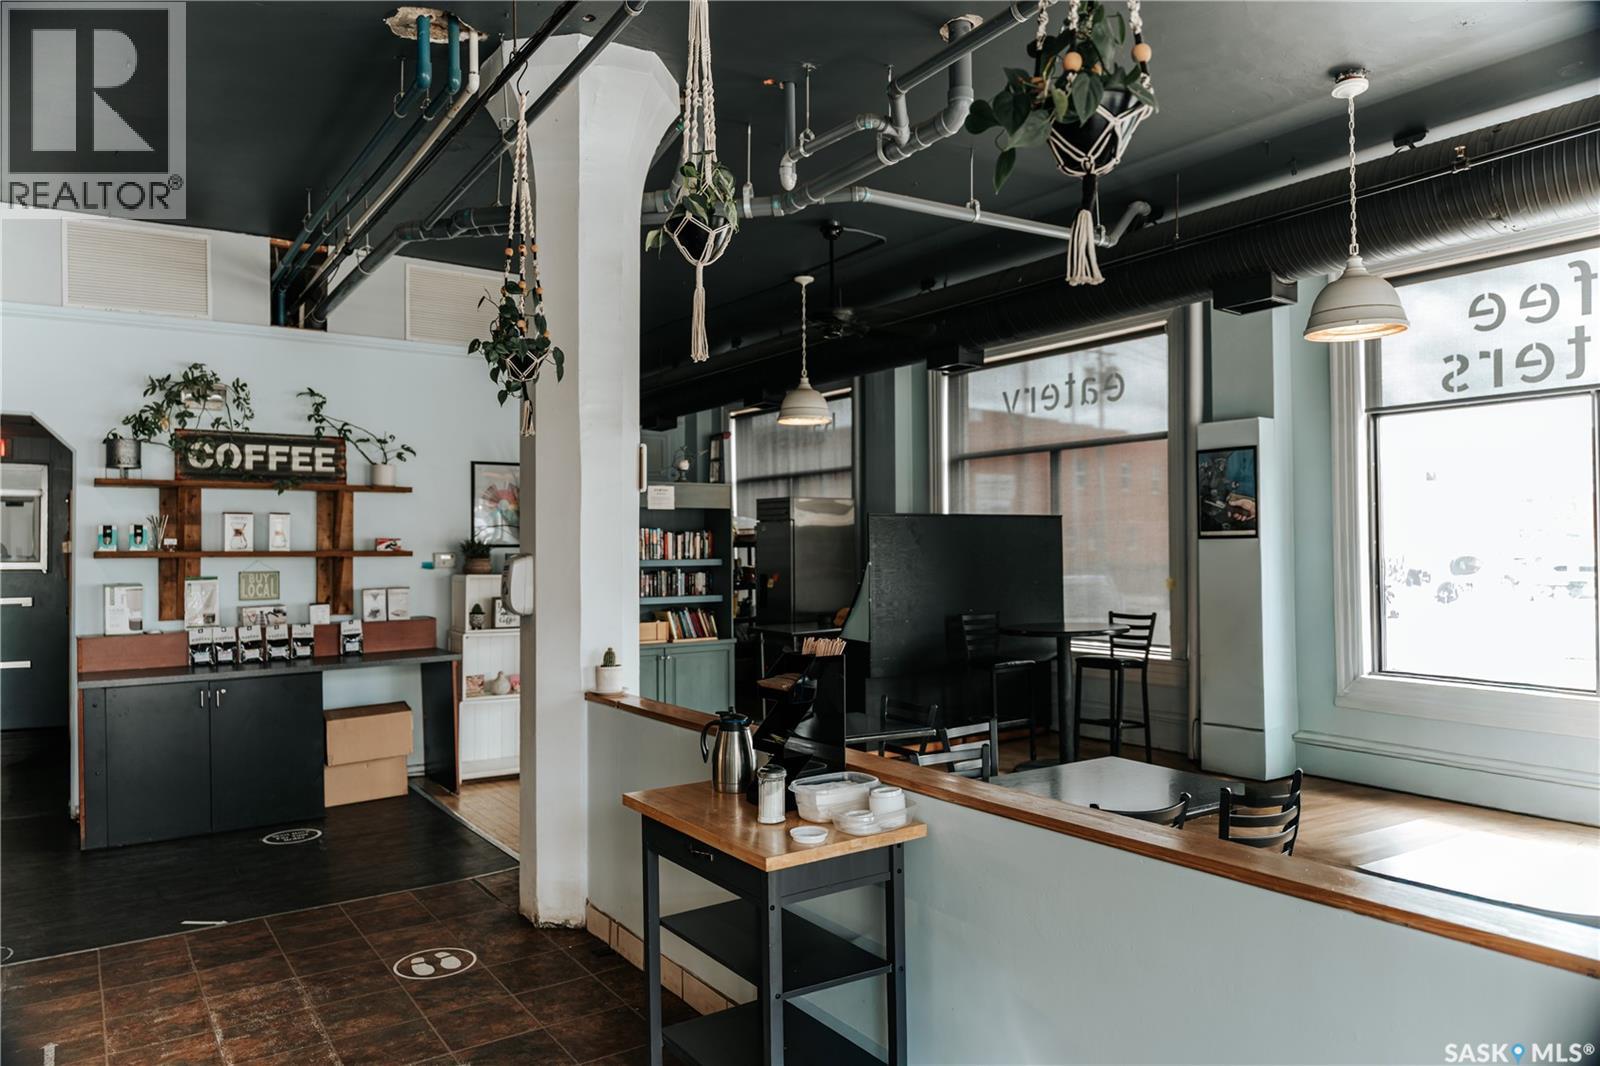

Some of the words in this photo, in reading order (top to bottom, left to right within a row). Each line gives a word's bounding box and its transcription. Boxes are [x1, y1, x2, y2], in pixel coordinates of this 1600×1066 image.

[187, 442, 336, 472] COFFEE
[241, 577, 277, 598] LOCAL
[248, 573, 270, 584] BUY
